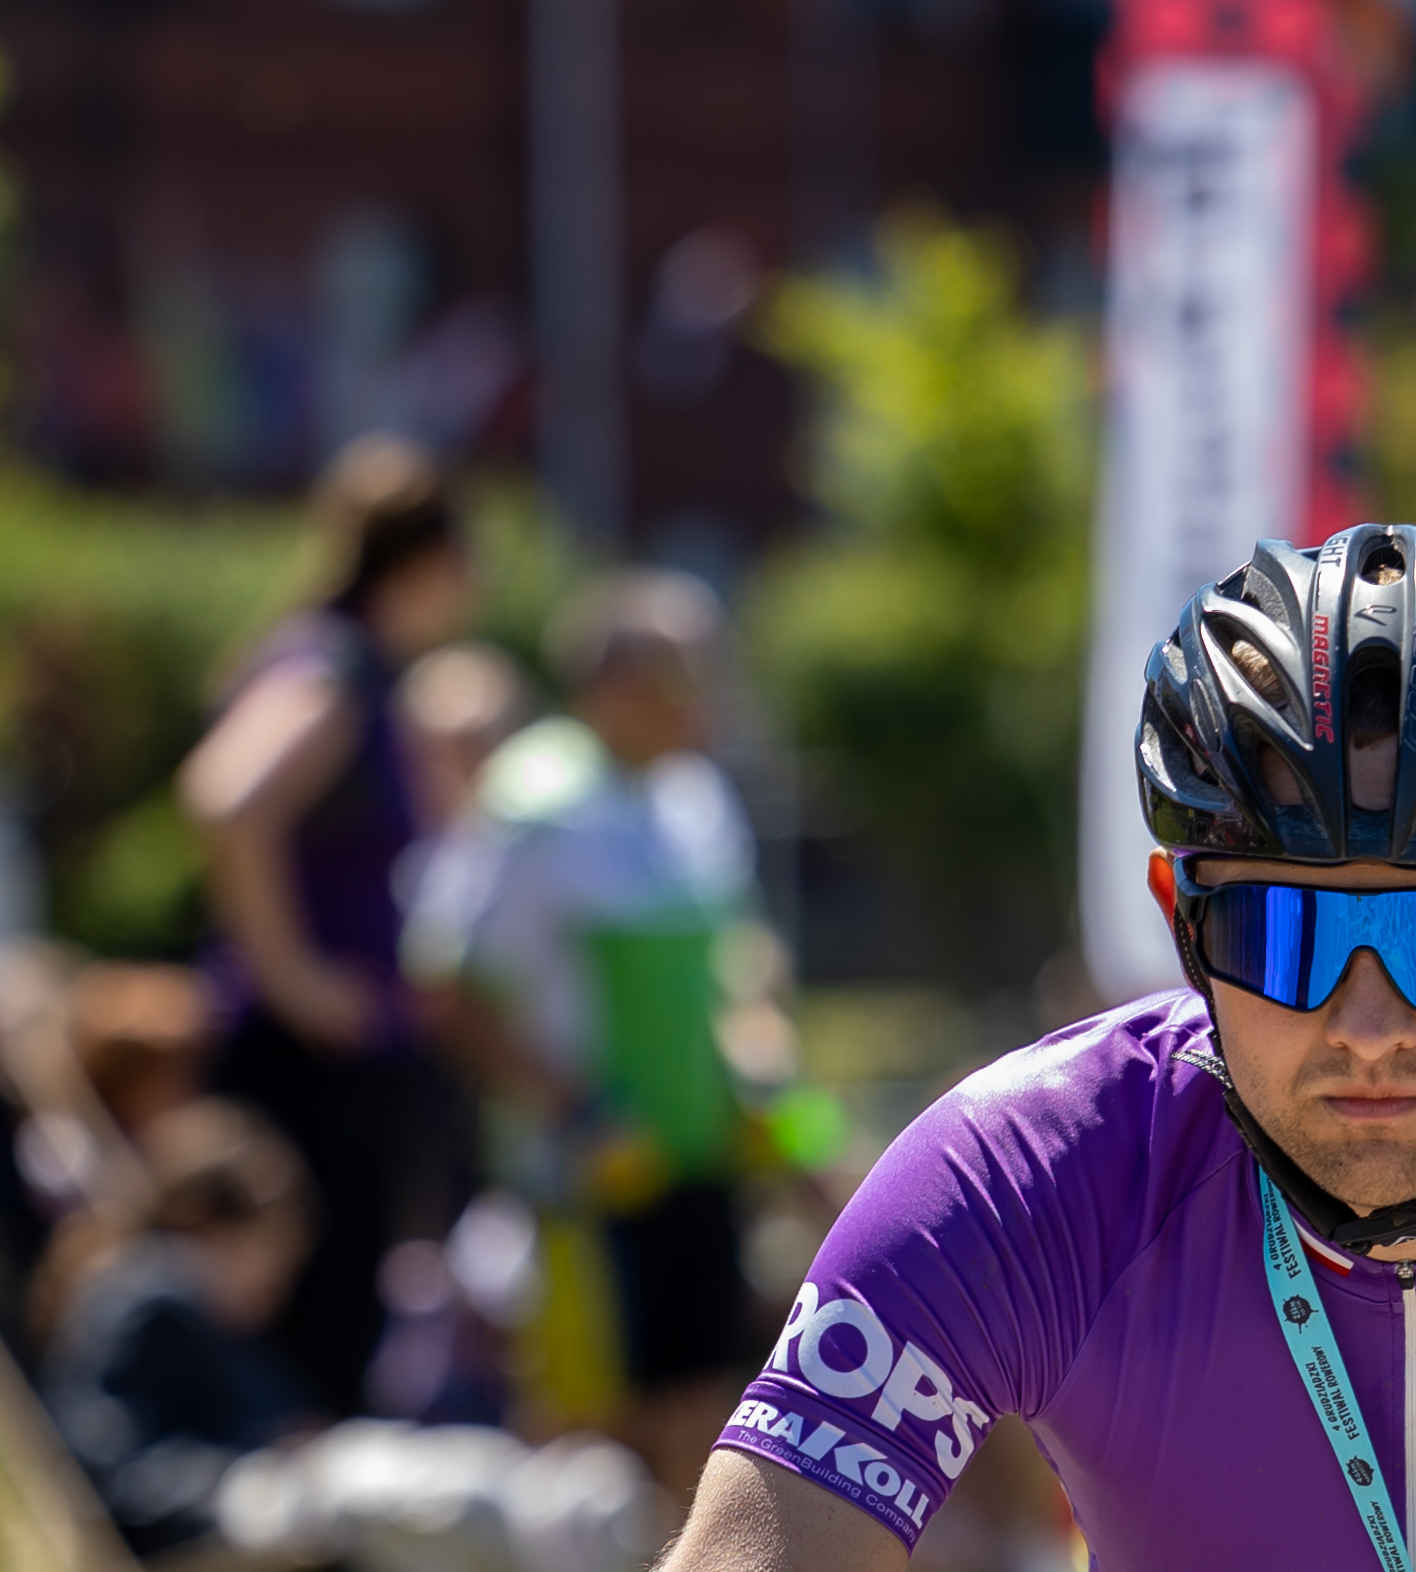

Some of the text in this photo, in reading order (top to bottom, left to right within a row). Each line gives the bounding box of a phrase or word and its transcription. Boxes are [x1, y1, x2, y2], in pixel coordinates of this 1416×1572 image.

[1312, 614, 1335, 744] MAGNETIC
[1273, 1263, 1282, 1271] 4
[1274, 1223, 1302, 1280] FESTIWAL
[1311, 1346, 1360, 1441] FESTIWAL ROWEROWY
[738, 1430, 917, 1544] The GreenBuilding Company
